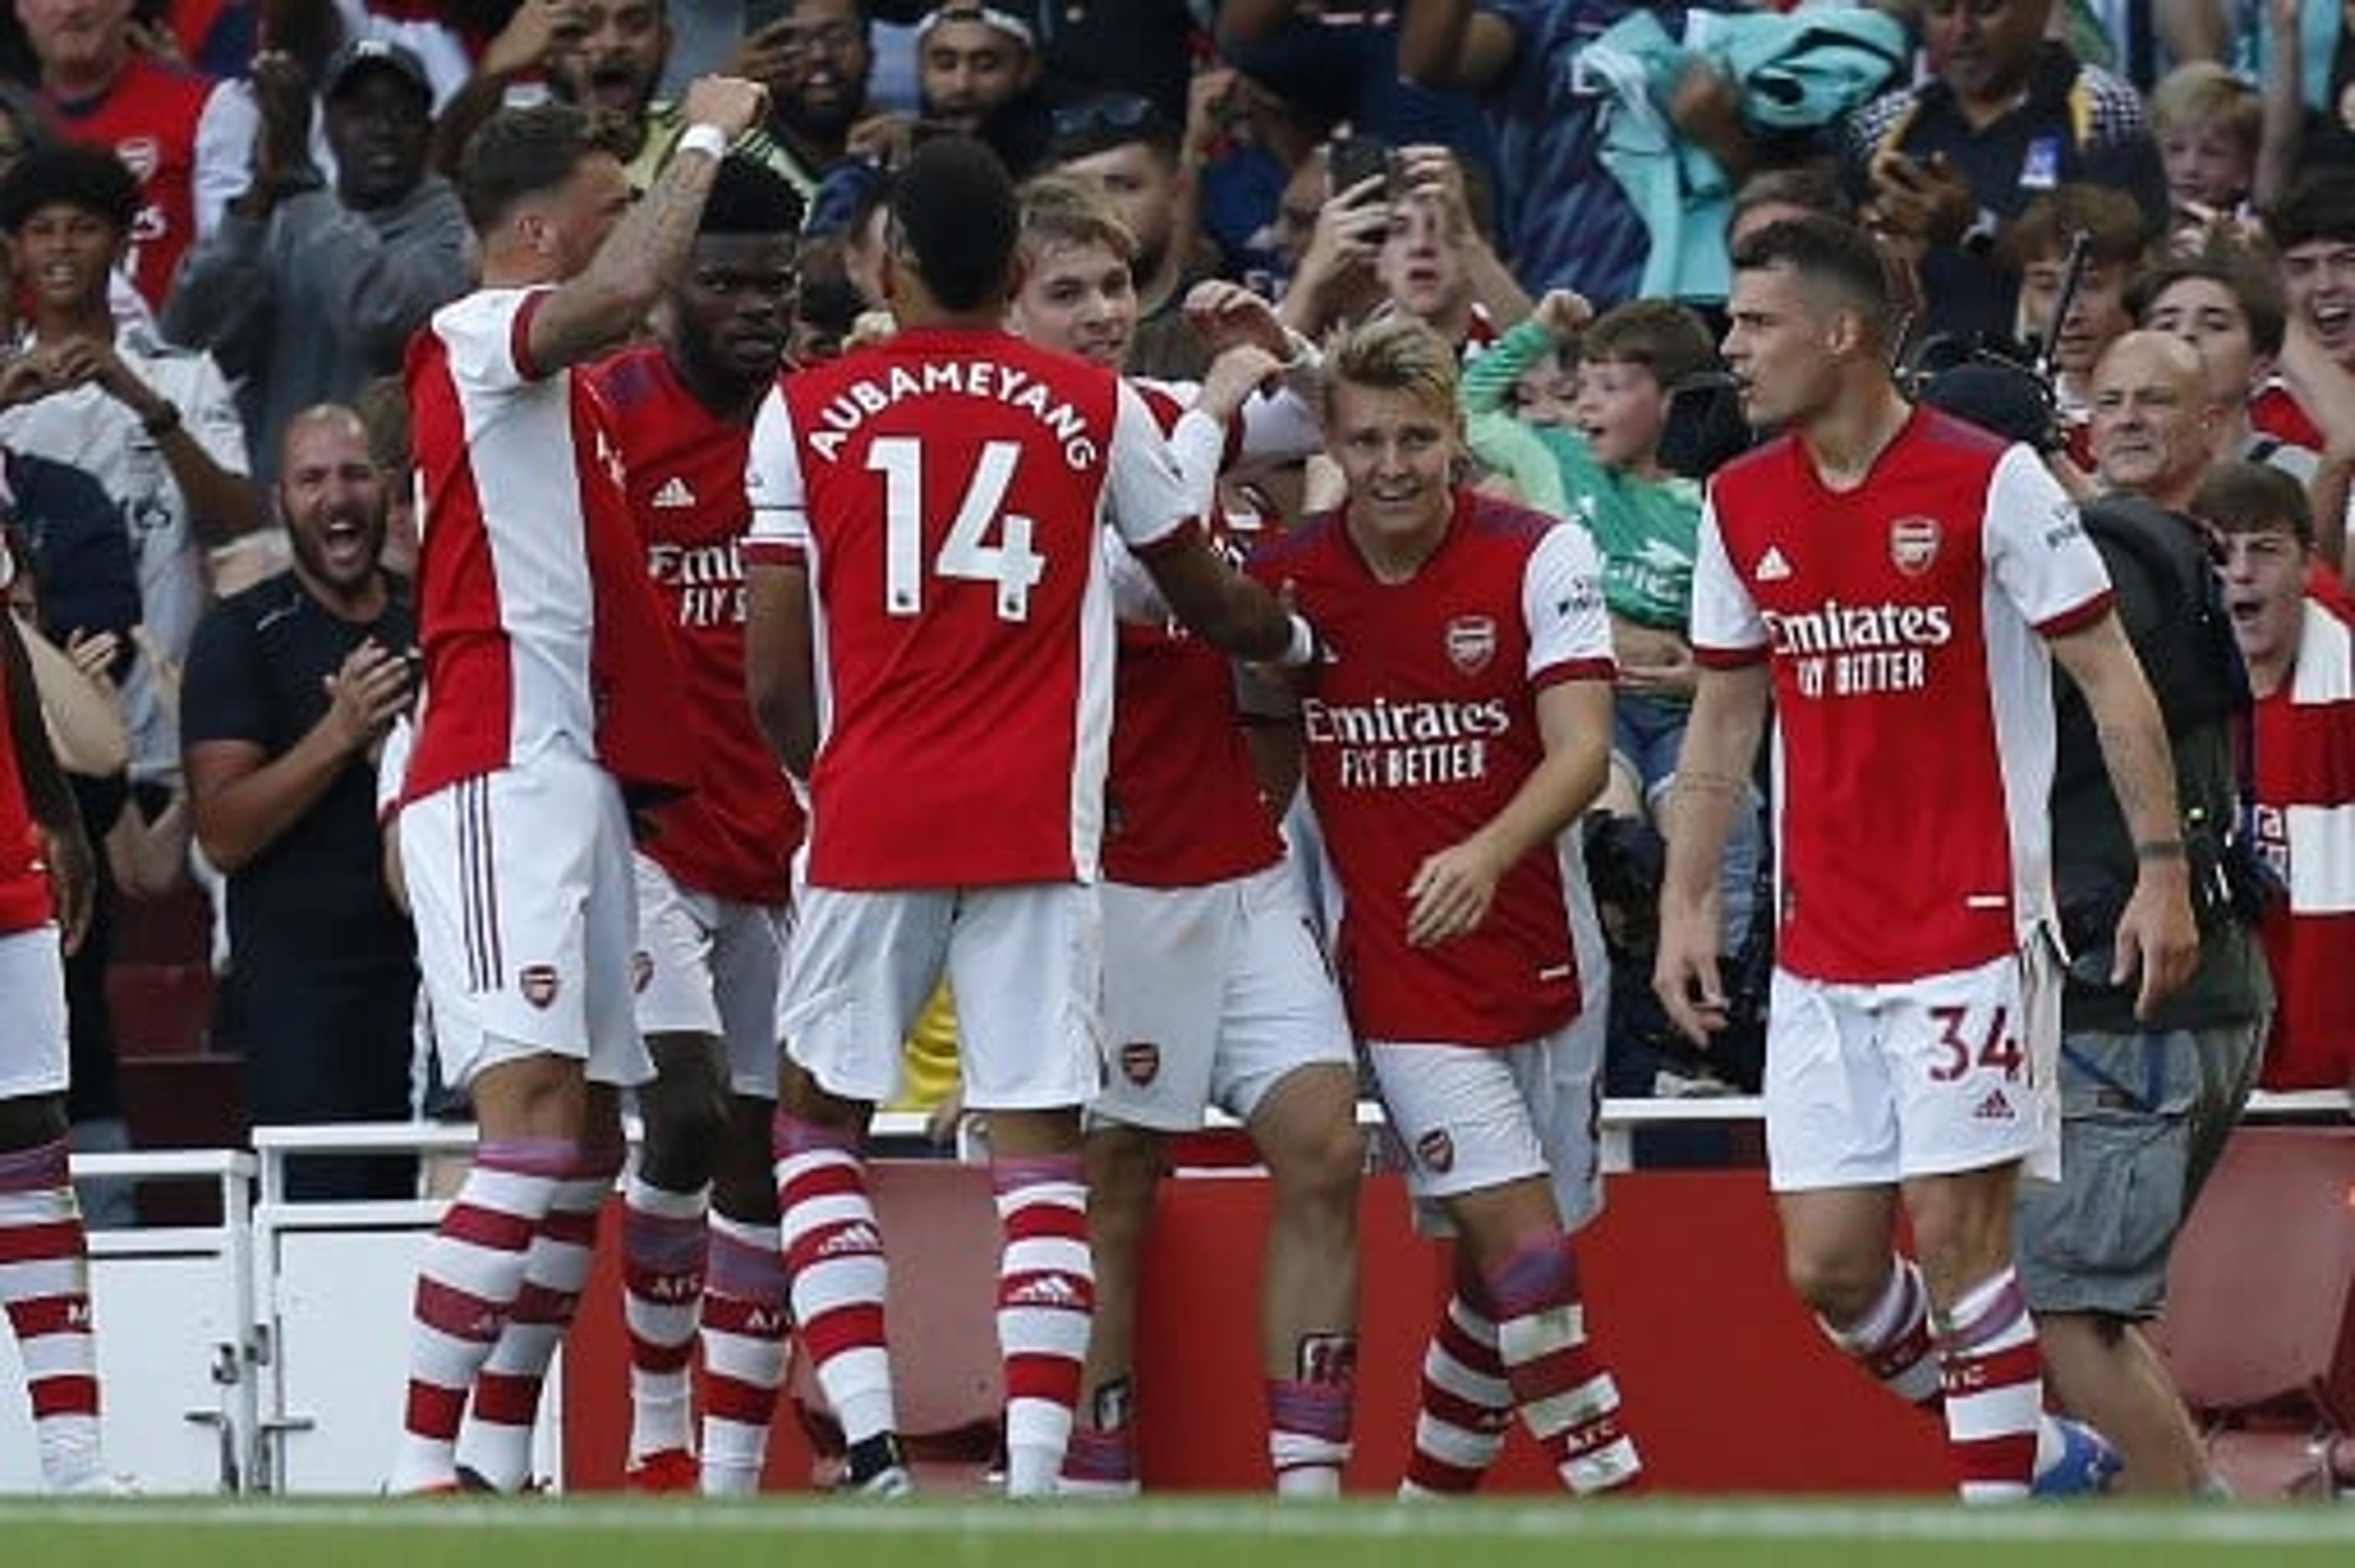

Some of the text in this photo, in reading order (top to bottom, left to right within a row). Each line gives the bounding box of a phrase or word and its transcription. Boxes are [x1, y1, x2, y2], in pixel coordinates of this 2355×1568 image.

[808, 362, 1097, 470] AUBAMEYANG
[865, 435, 1046, 622] 14
[1761, 600, 1951, 654] Emirates
[1302, 698, 1510, 743] Emirates
[1387, 740, 1485, 787] BETTER
[1928, 1006, 2024, 1082] 34
